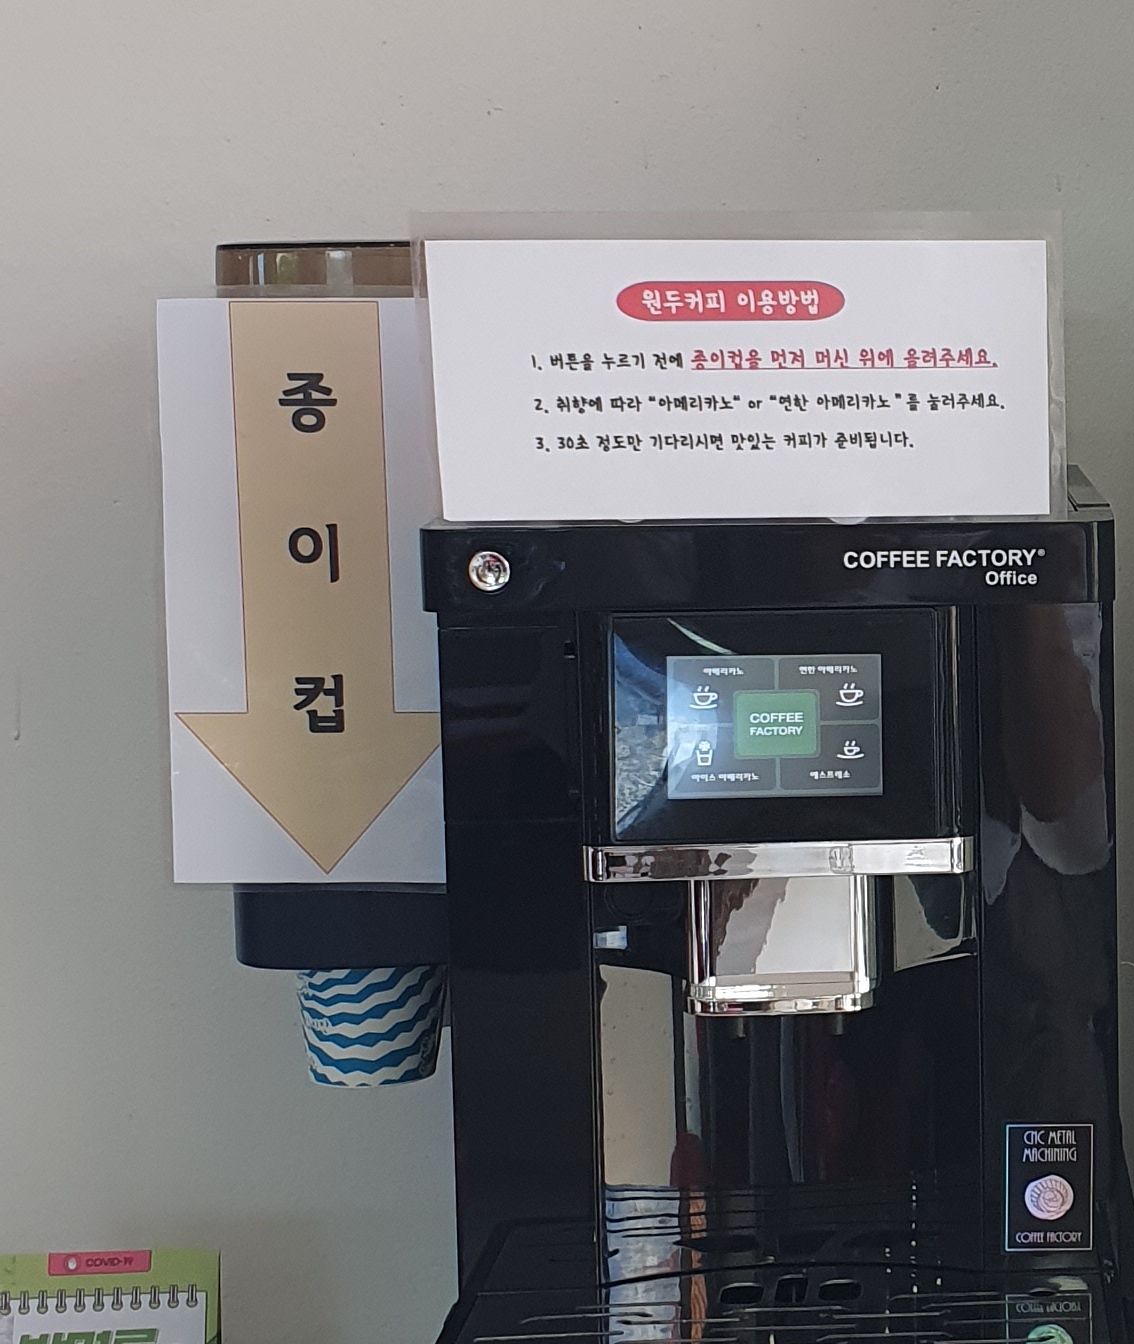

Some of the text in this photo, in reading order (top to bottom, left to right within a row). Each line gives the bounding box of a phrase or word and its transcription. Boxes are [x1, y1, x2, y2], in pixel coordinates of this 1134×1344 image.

[641, 289, 819, 315] 원두커피 이용방법
[531, 347, 998, 371] 1. 버튼을 누르기 전에 종이컵을 먼저 머신 위에 올려주세요.
[533, 398, 549, 413] 2.
[556, 396, 603, 414] 취향에
[610, 396, 642, 412] 따라
[748, 399, 763, 410] or
[927, 393, 1005, 411] 눌러주세요.
[535, 431, 914, 452] 3. 30초 정도만 기다리시면 맛있는 커피가 준비됩니다.
[843, 550, 930, 568] COFFEE
[985, 570, 1038, 585] Office
[750, 712, 804, 724] COFFEE
[750, 726, 803, 736] FACTORY
[1048, 1130, 1077, 1145] METAL
[1022, 1147, 1077, 1162] MACHINING
[1015, 1231, 1082, 1244] COFFEE FACTORY
